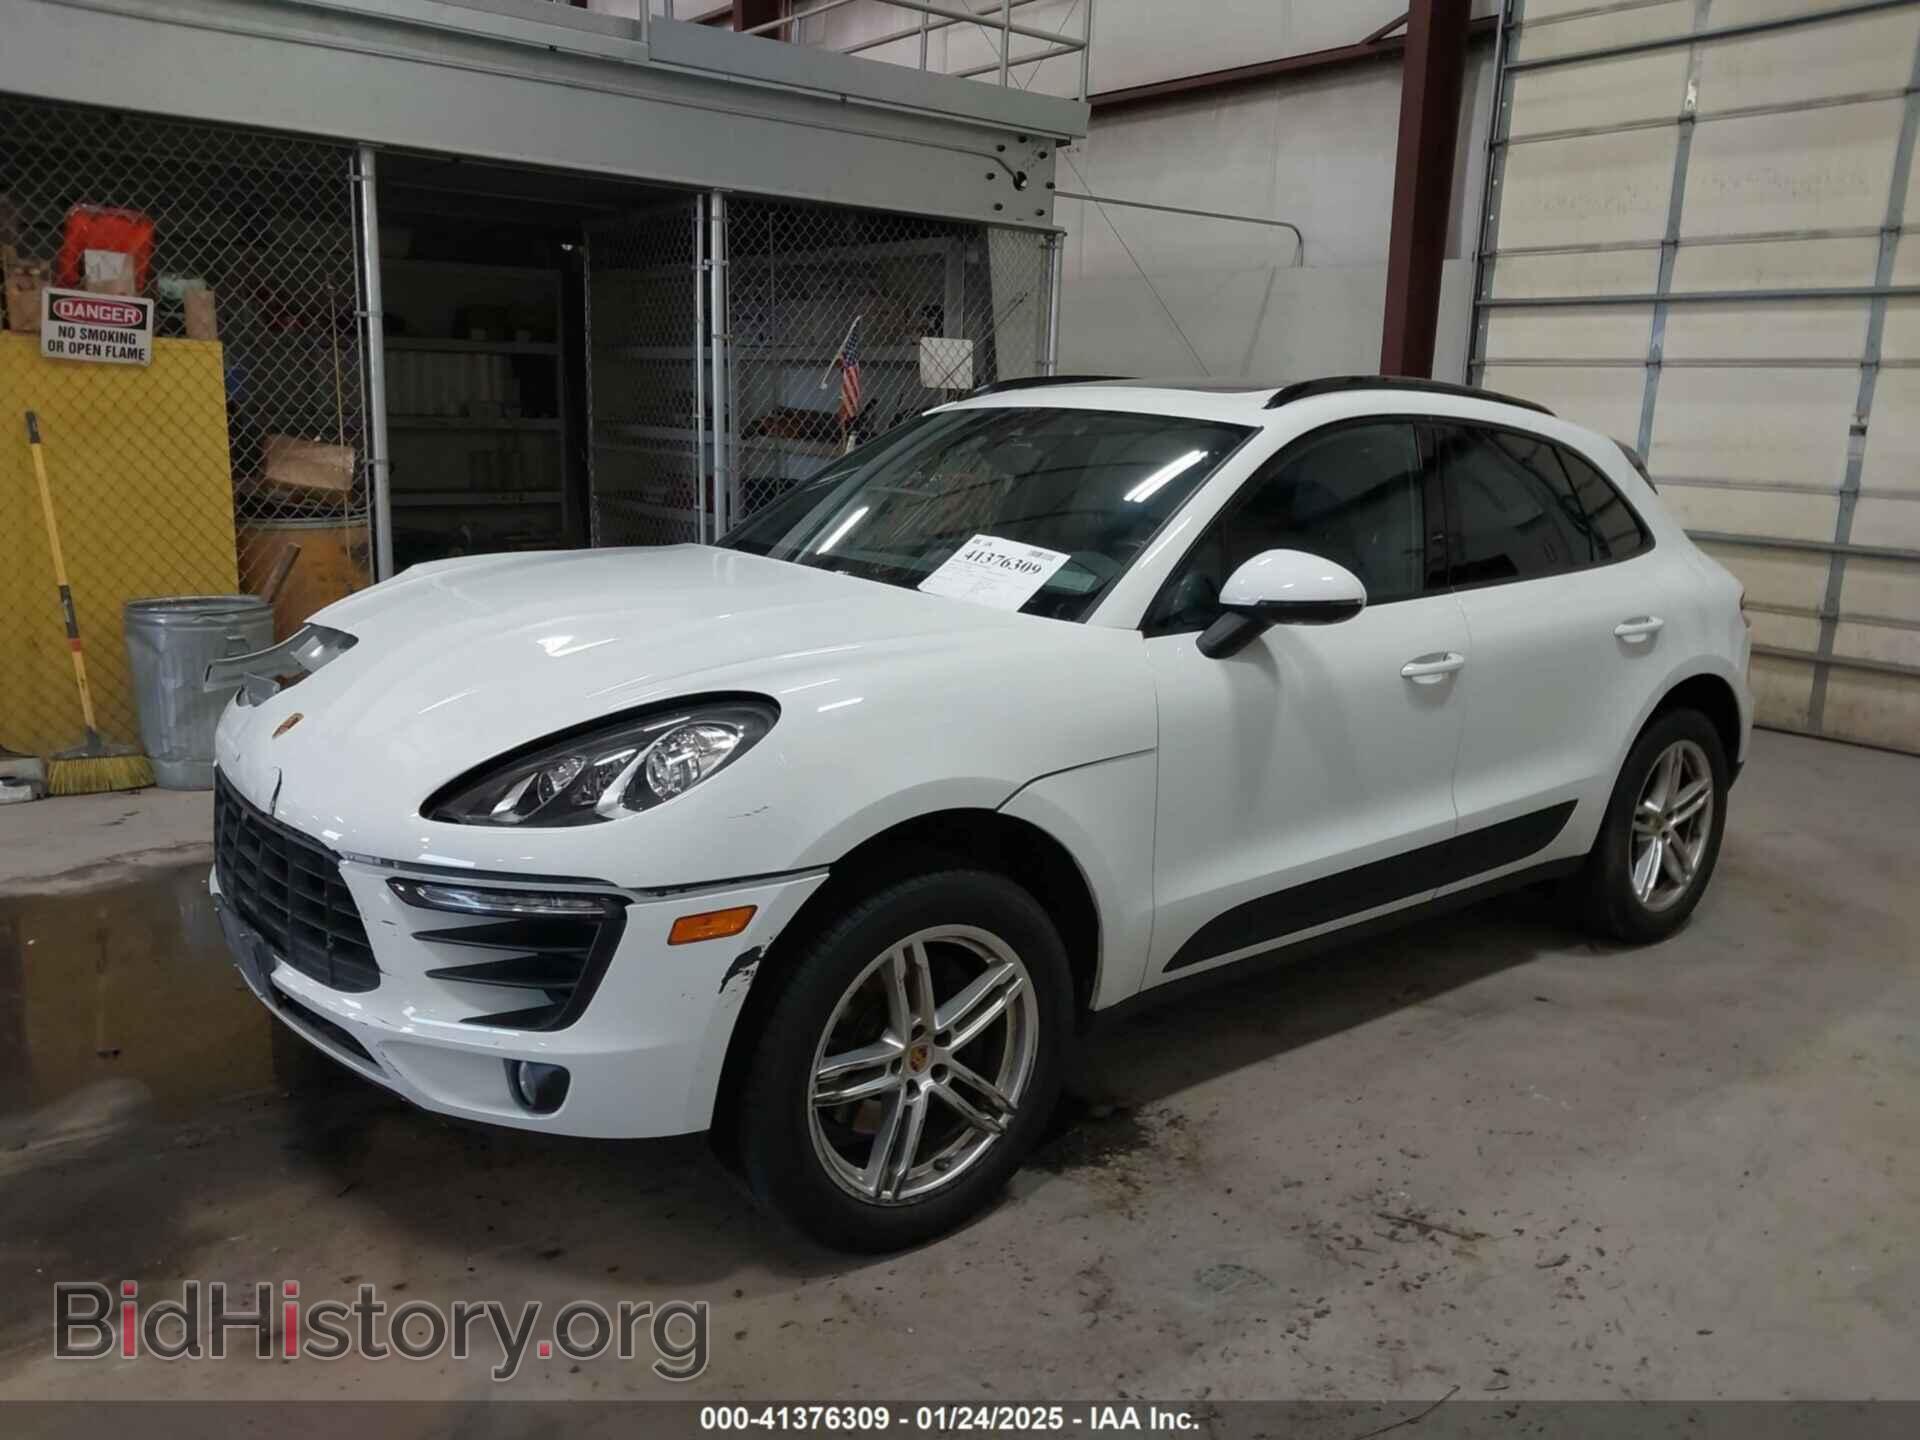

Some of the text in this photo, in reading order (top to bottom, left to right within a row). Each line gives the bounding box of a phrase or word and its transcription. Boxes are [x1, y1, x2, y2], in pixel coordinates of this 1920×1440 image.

[60, 301, 137, 323] DANGER
[58, 325, 136, 345] NO SMOKING
[48, 339, 145, 361] OR OPEN FLAME
[965, 549, 1042, 575] 41376309
